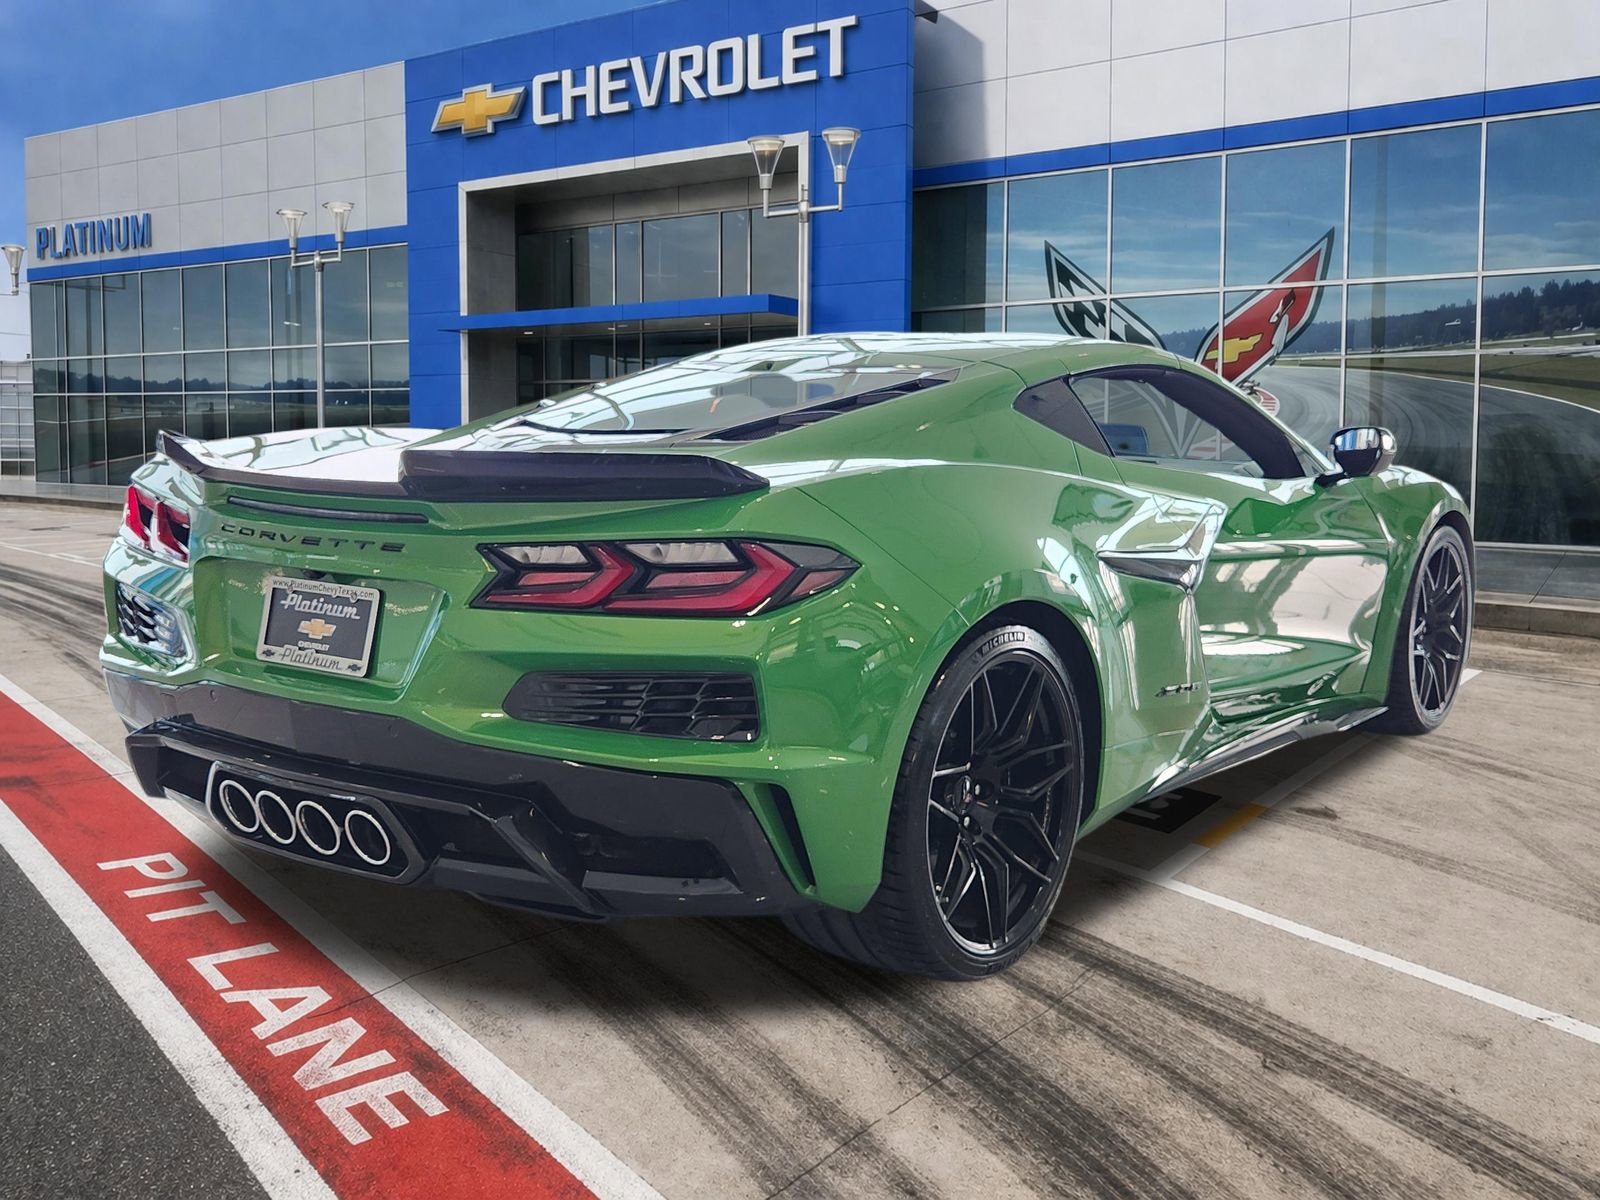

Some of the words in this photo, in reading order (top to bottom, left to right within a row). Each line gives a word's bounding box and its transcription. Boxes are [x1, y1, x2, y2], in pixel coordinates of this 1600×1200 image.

[532, 15, 858, 126] CHEVROLET
[36, 213, 152, 260] PLATINUM
[221, 523, 405, 552] CORVETTE
[280, 593, 361, 620] Platinum
[982, 632, 1024, 654] MICHELIN
[279, 647, 342, 670] Platinum
[96, 852, 247, 924] PIT
[187, 942, 450, 1146] LANE
